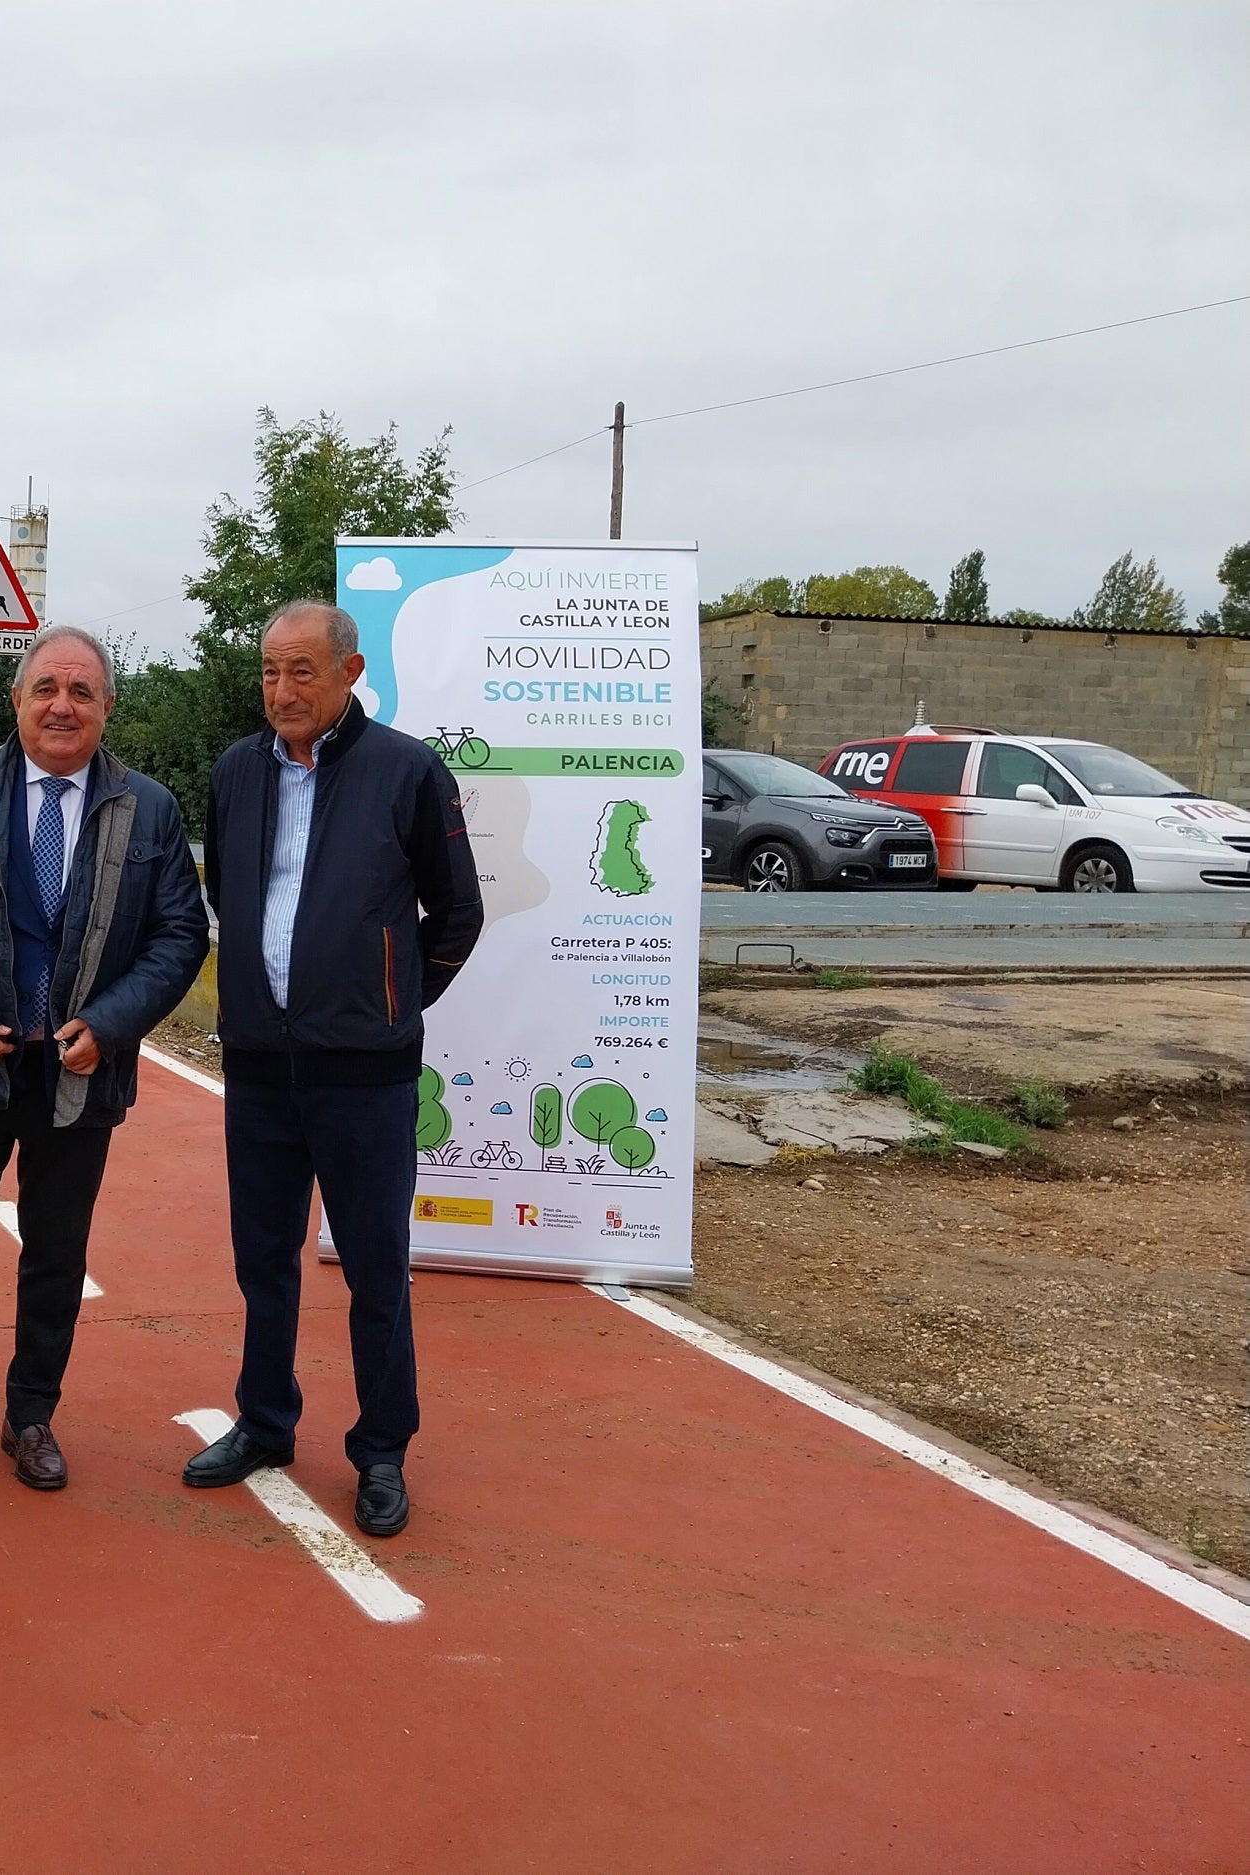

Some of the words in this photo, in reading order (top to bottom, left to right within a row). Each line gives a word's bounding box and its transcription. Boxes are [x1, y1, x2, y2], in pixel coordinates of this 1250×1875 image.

[490, 568, 551, 591] AQUÍ
[560, 572, 669, 591] INVIERTE
[556, 598, 579, 610] LA
[583, 598, 640, 611] JUNTA
[645, 600, 669, 612] DE
[519, 614, 603, 627] CASTILLA
[606, 616, 618, 628] Y
[623, 616, 670, 628] LEON
[486, 646, 671, 670] MOVILIDAD
[484, 680, 672, 703] SOSTENIBLE
[526, 712, 623, 726] CARRILES
[632, 714, 672, 726] BICI
[561, 754, 675, 771] PALENCIA
[833, 751, 890, 784] rne
[1084, 810, 1102, 820] 107
[582, 913, 672, 926] ACTUACIÓN
[550, 936, 621, 948] Carretera
[625, 938, 635, 948] P
[640, 938, 672, 949] 405:
[551, 953, 565, 961] de
[567, 953, 610, 962] Palencia
[621, 953, 671, 962] Villalobón
[592, 974, 671, 985] LONGITUD
[614, 995, 641, 1007] 1,78
[646, 995, 670, 1006] km
[599, 1015, 669, 1027] IMPORTE
[594, 1036, 653, 1048] 769.264
[657, 1037, 669, 1049] €
[624, 1222, 648, 1230] Junta
[600, 1229, 630, 1237] Castilla
[631, 1231, 637, 1239] y
[639, 1231, 660, 1239] León
